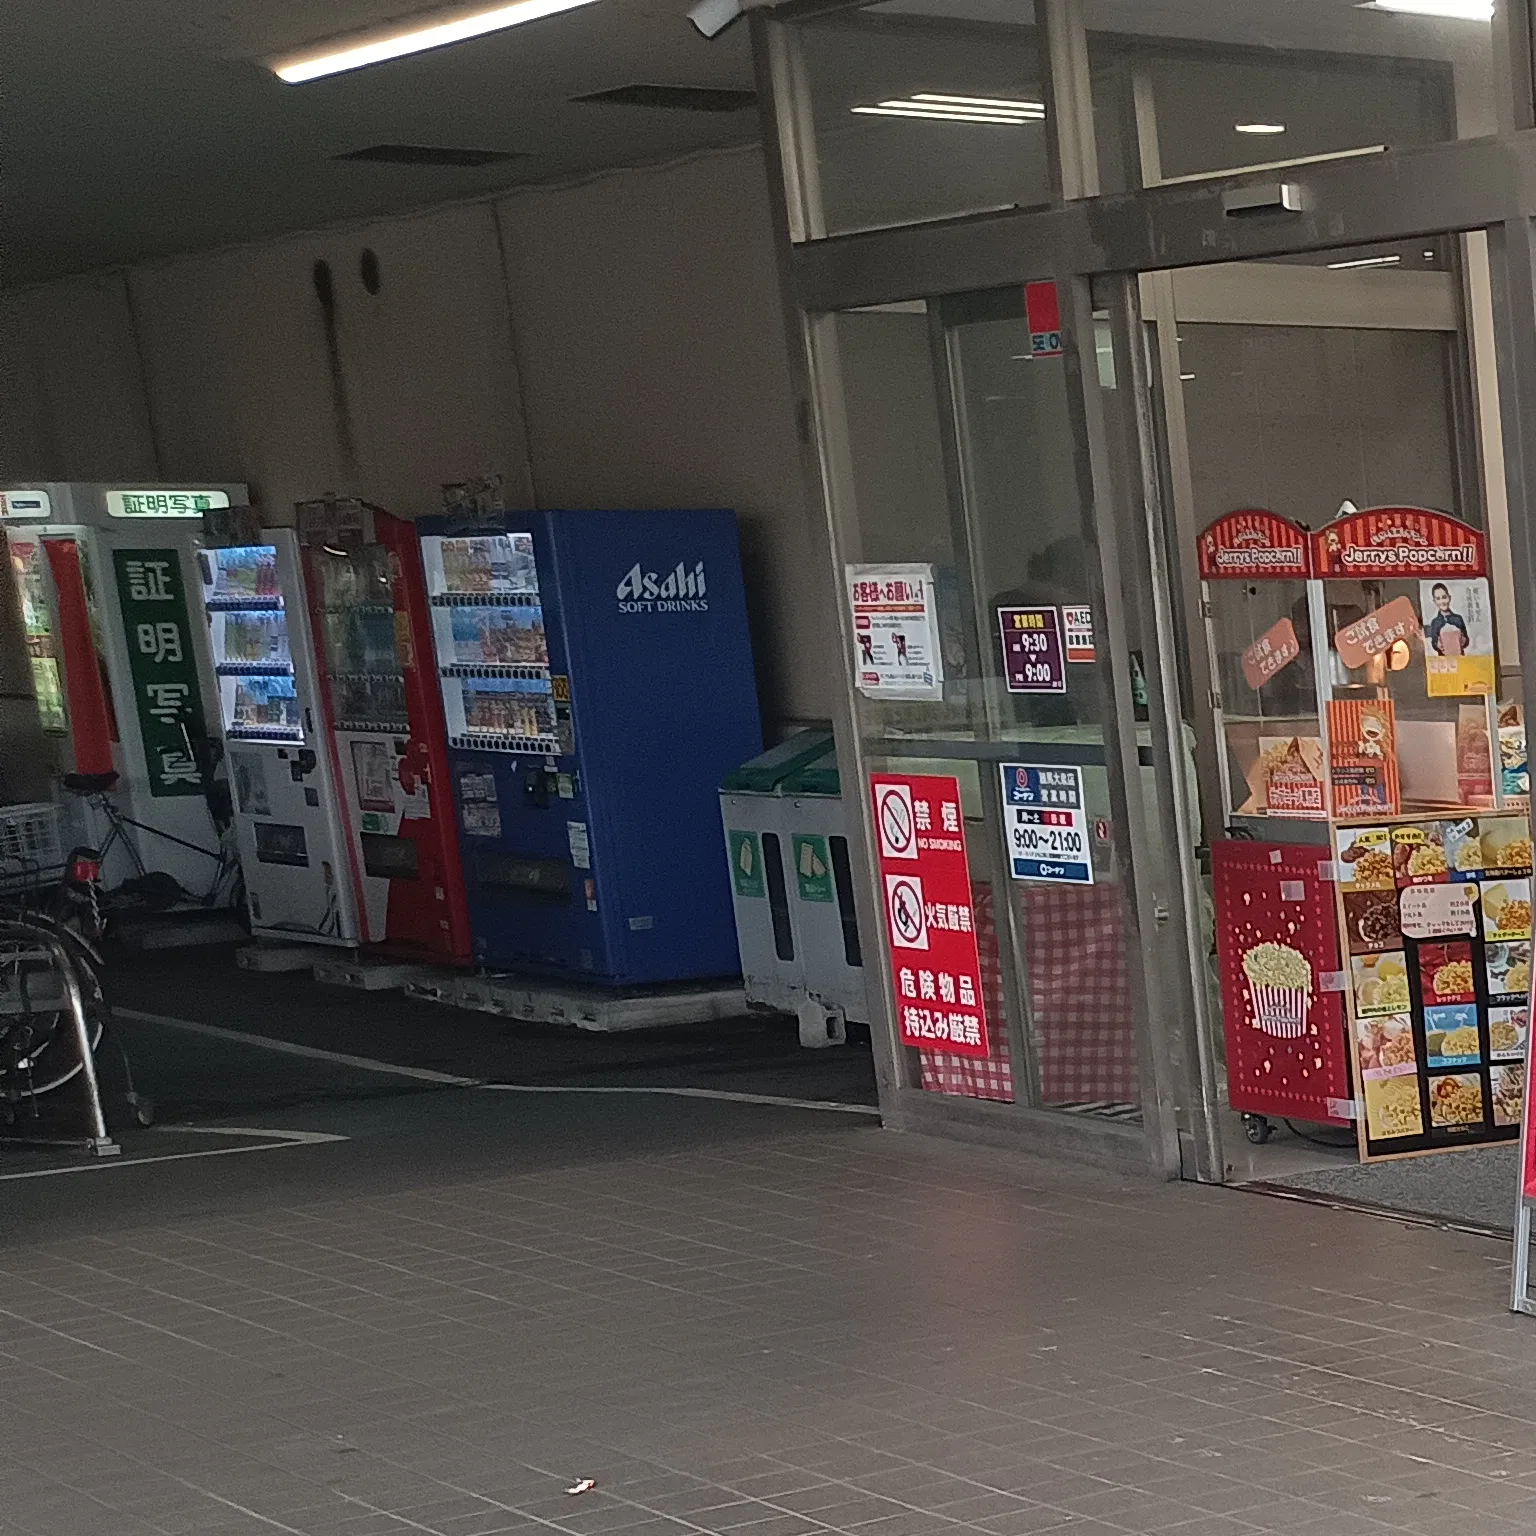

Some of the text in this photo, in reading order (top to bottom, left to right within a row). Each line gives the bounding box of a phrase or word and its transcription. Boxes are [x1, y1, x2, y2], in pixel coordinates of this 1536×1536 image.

[121, 494, 211, 515] 証明写真
[1215, 549, 1251, 567] Jerrys
[1341, 546, 1474, 566] Jerrys Popcorn!!
[616, 561, 707, 600] Asahi
[617, 599, 709, 614] SOFT DRINKS
[1021, 633, 1048, 653] 9:30
[126, 560, 202, 785] 証明写真
[1025, 663, 1051, 682] 9:00
[913, 800, 960, 832] 禁煙
[917, 837, 962, 852] NO SMOKING
[924, 902, 972, 933] 火気厳禁
[899, 966, 977, 1007] 危険物品
[903, 1005, 982, 1046] 持込み厳禁
